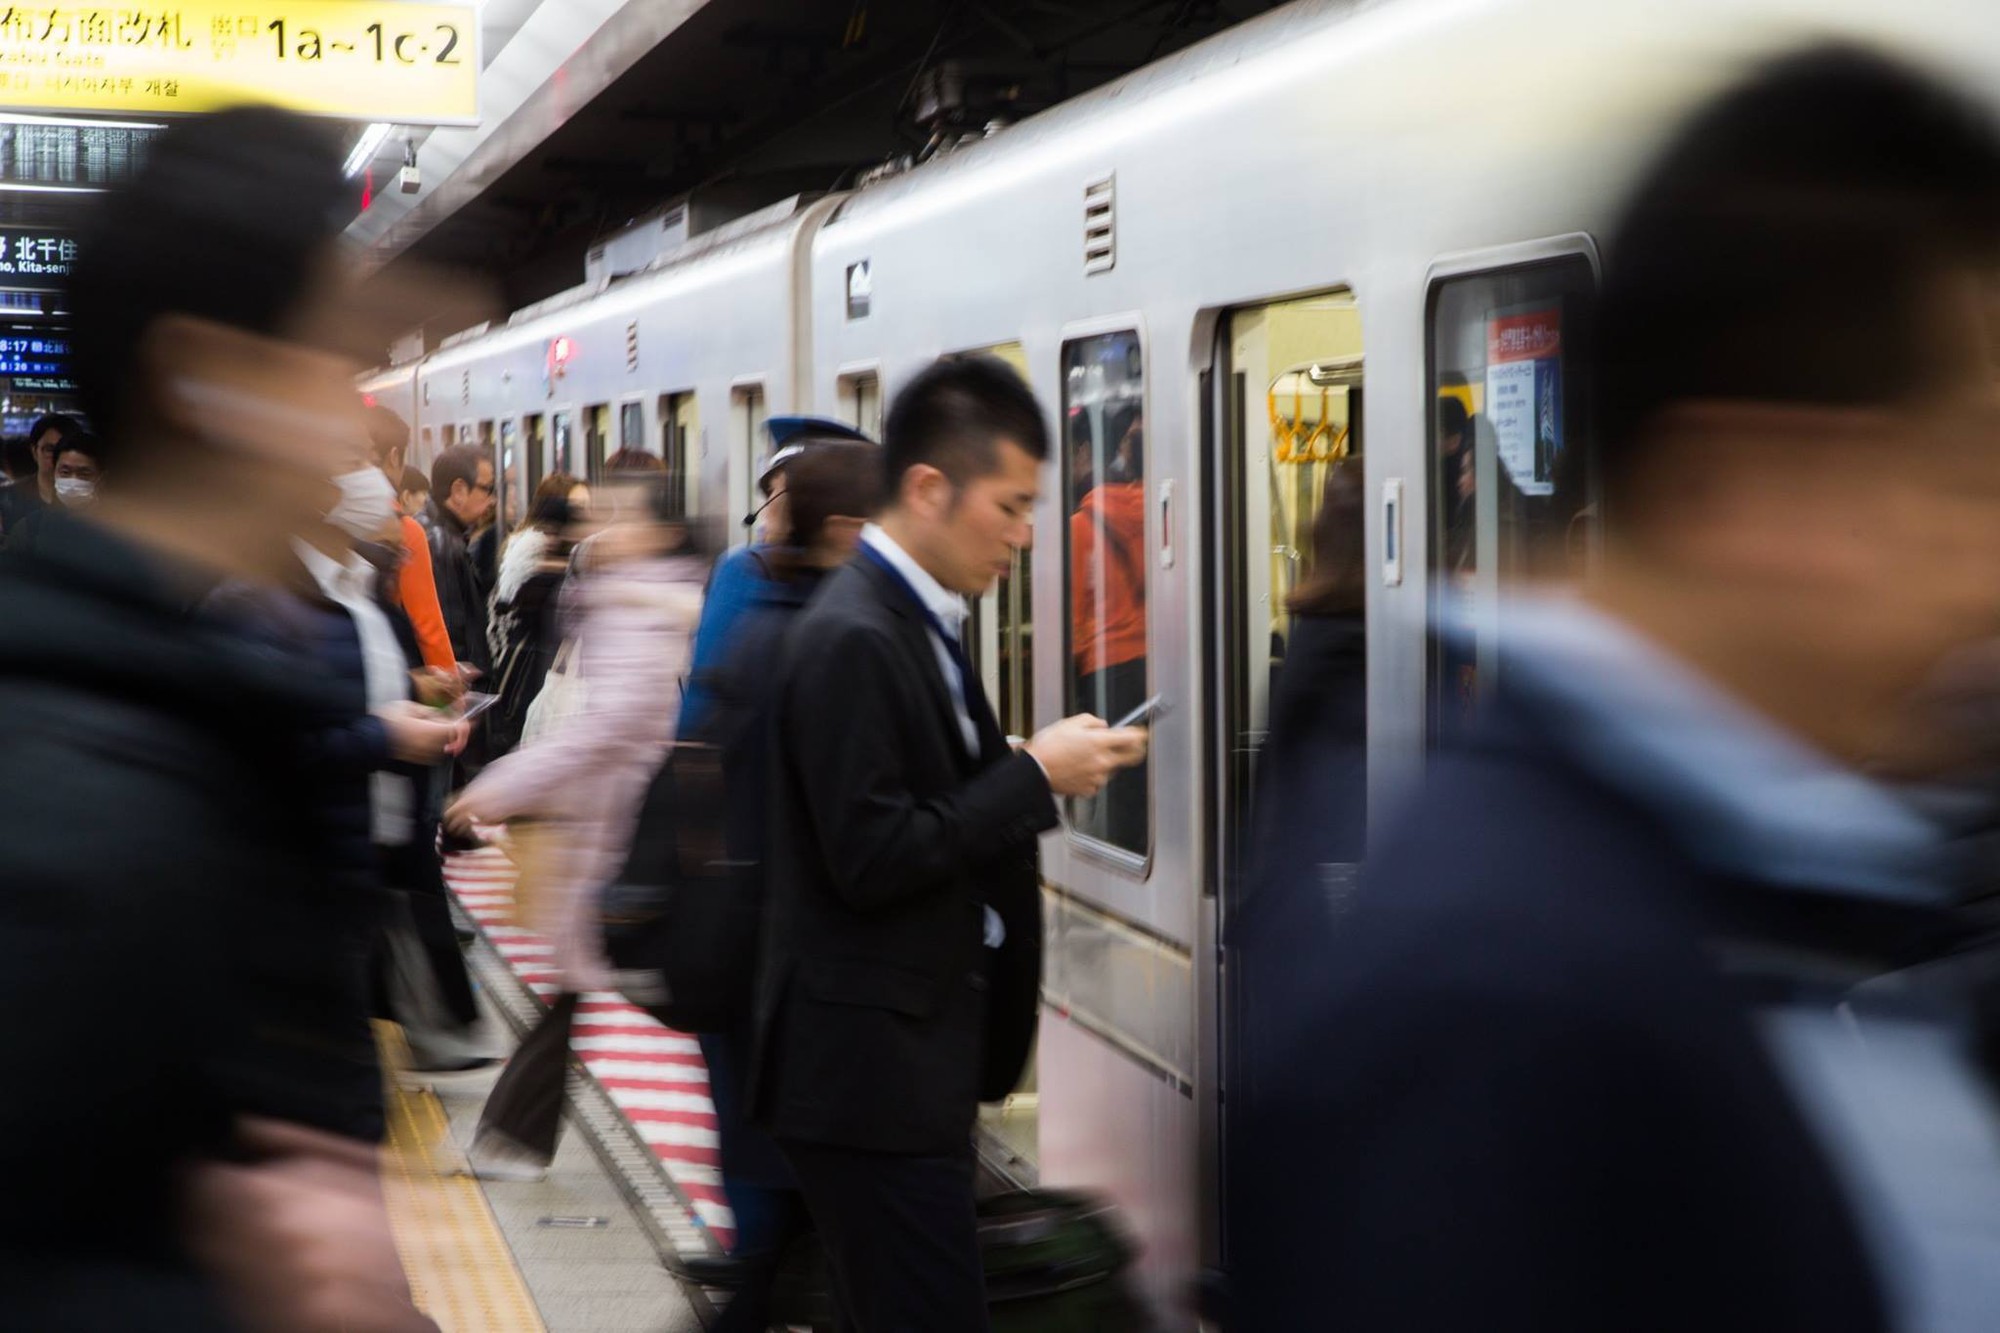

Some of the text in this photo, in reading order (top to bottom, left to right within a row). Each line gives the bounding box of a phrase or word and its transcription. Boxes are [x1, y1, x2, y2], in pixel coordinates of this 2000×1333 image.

[15, 236, 78, 261] 北千住
[18, 260, 74, 276] Kita-senj
